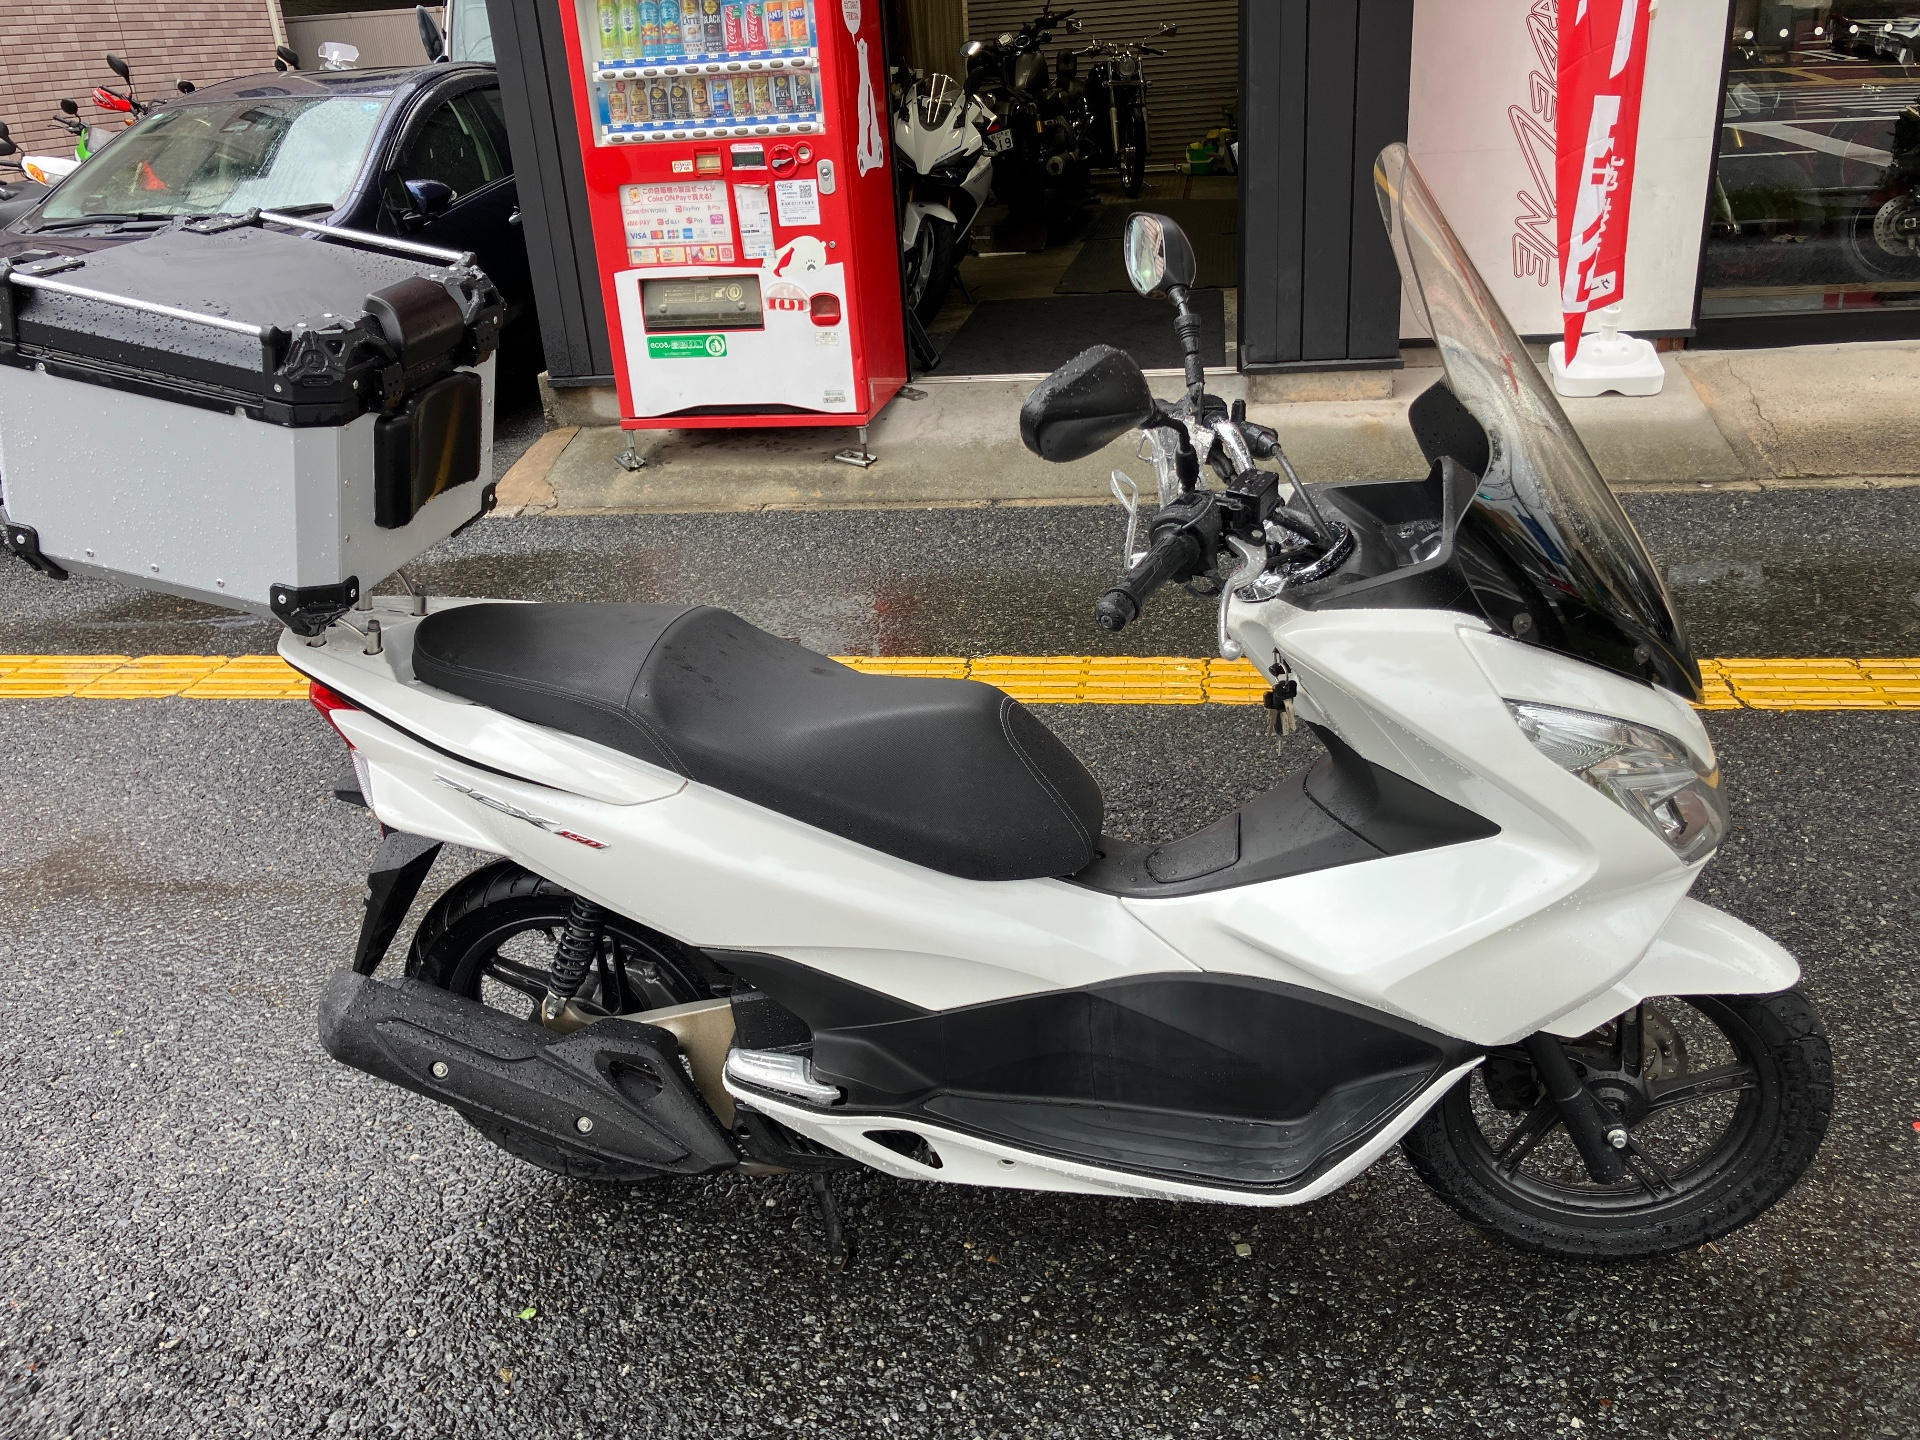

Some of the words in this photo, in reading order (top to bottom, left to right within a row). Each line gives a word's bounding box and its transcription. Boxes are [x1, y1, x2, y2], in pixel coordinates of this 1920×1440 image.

[683, 16, 700, 25] LATTE
[703, 14, 721, 24] BLACK
[647, 195, 664, 203] Coke
[664, 194, 675, 202] ON
[629, 232, 648, 240] VISA
[553, 828, 612, 850] 150
